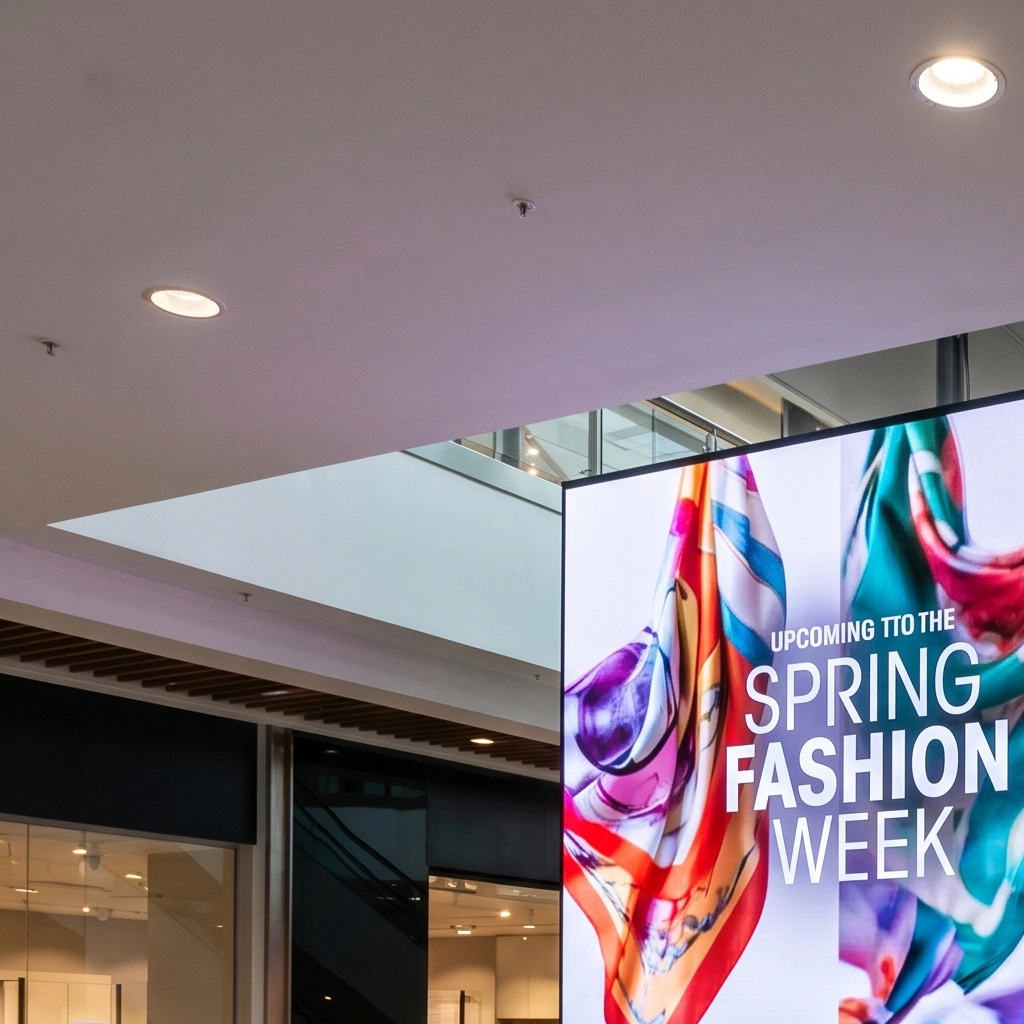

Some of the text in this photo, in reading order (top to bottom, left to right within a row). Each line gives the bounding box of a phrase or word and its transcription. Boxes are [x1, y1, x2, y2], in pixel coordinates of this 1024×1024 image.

[771, 607, 955, 653] UPCOMING TTO THE
[744, 641, 981, 735] SPRING
[725, 718, 1009, 813] FASHION
[772, 805, 956, 885] WEEK
